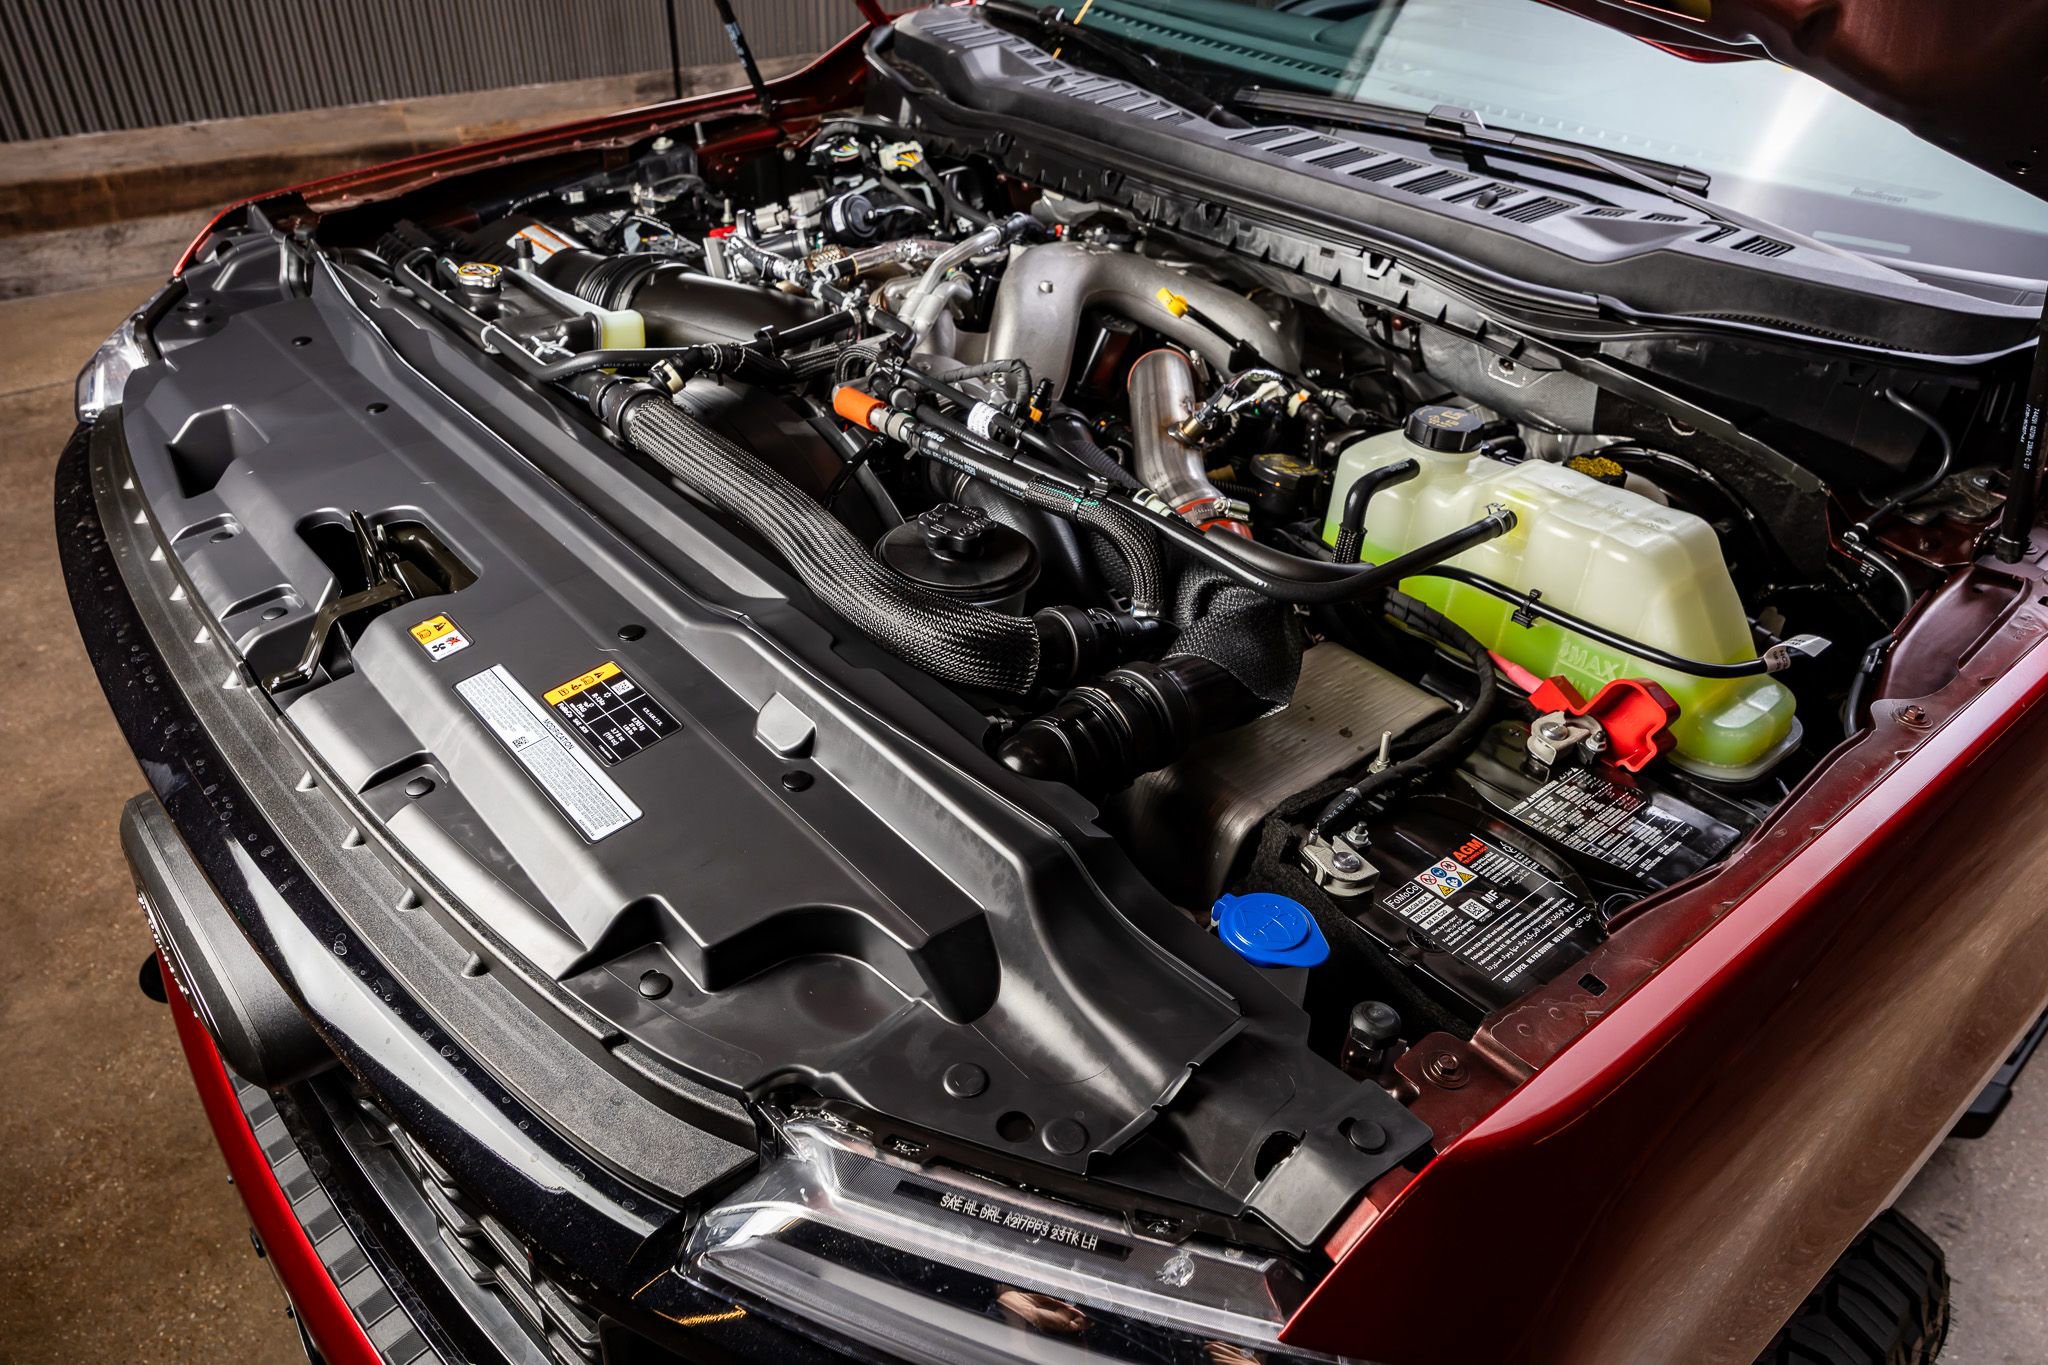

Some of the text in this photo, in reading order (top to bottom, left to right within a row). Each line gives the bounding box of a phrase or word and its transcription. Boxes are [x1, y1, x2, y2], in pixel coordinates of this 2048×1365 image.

[544, 718, 575, 751] MODIFICATION
[1453, 839, 1484, 861] AGM
[1387, 885, 1419, 907] FoMoCo
[1481, 889, 1498, 904] MF
[940, 1194, 963, 1212] SAE
[963, 1201, 978, 1216] HL
[980, 1206, 1001, 1224] DRL
[1081, 1234, 1099, 1251] LH
